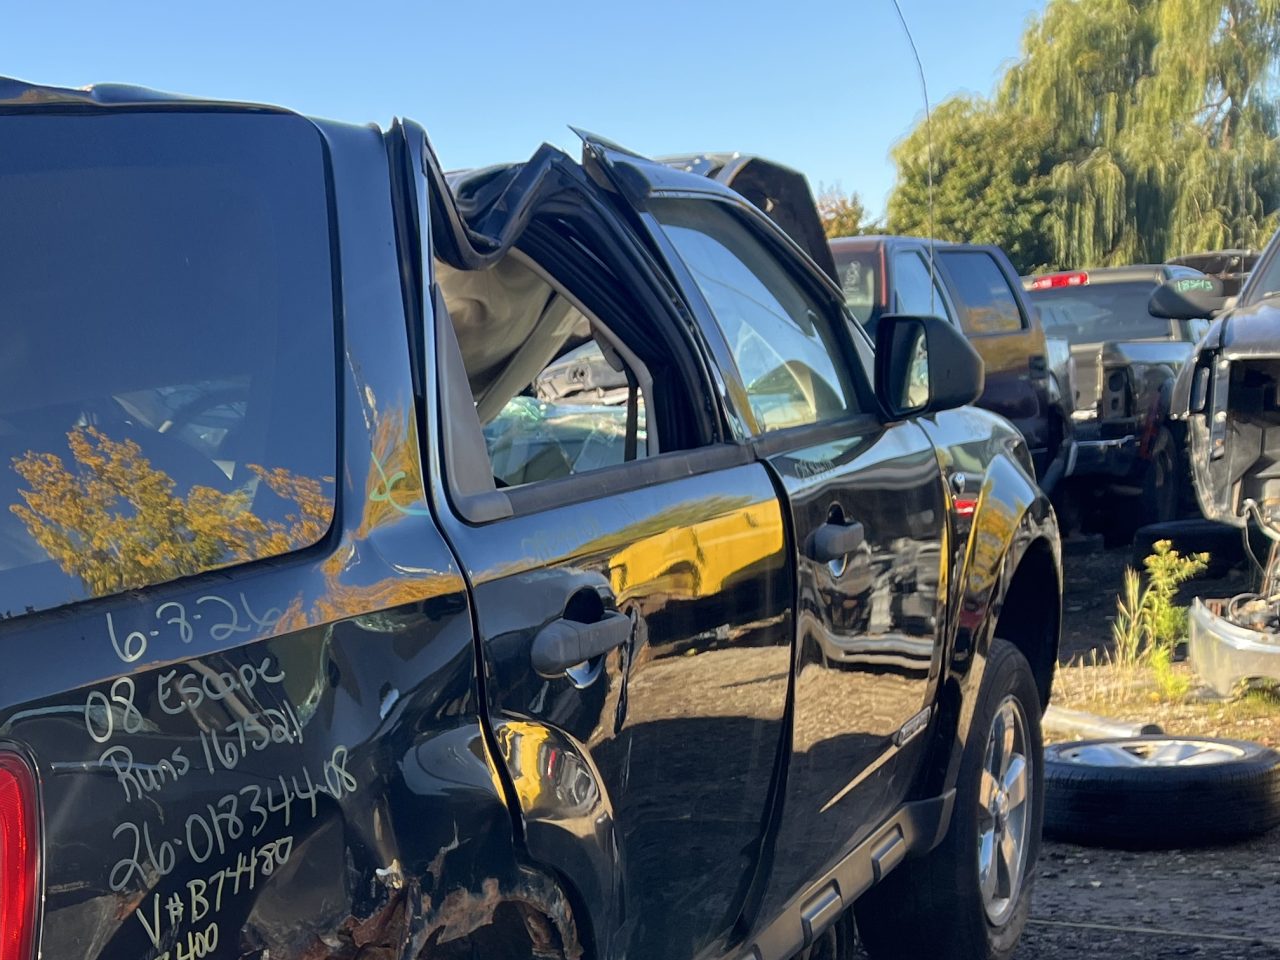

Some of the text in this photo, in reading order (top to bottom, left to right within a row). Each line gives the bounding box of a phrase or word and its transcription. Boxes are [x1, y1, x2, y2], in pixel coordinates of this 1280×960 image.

[85, 657, 286, 742] 08 Escape
[98, 745, 190, 802] Runs
